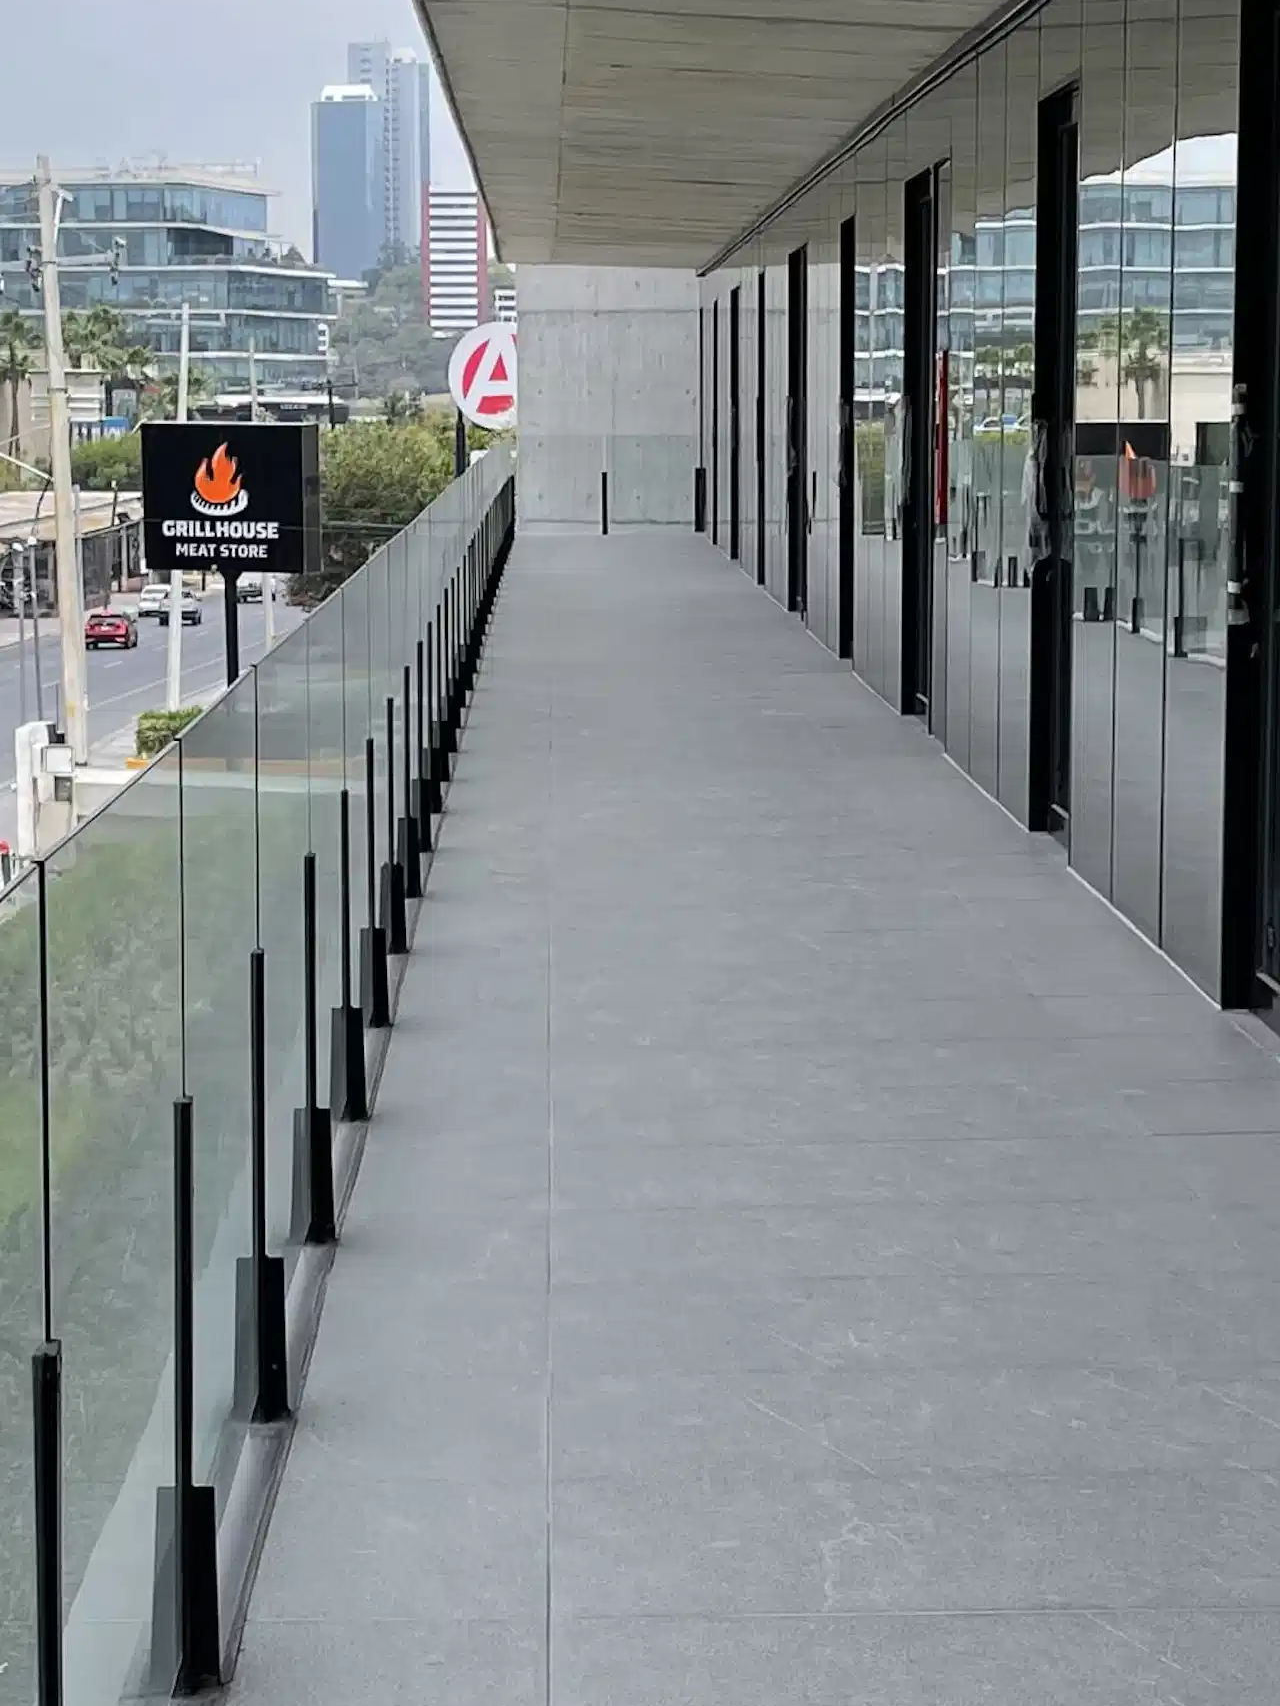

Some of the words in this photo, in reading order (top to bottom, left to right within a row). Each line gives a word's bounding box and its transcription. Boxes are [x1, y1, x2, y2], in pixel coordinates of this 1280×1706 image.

[161, 520, 280, 539] GRILLHOUSE
[175, 543, 217, 557] MEAT
[219, 544, 269, 559] STORE
